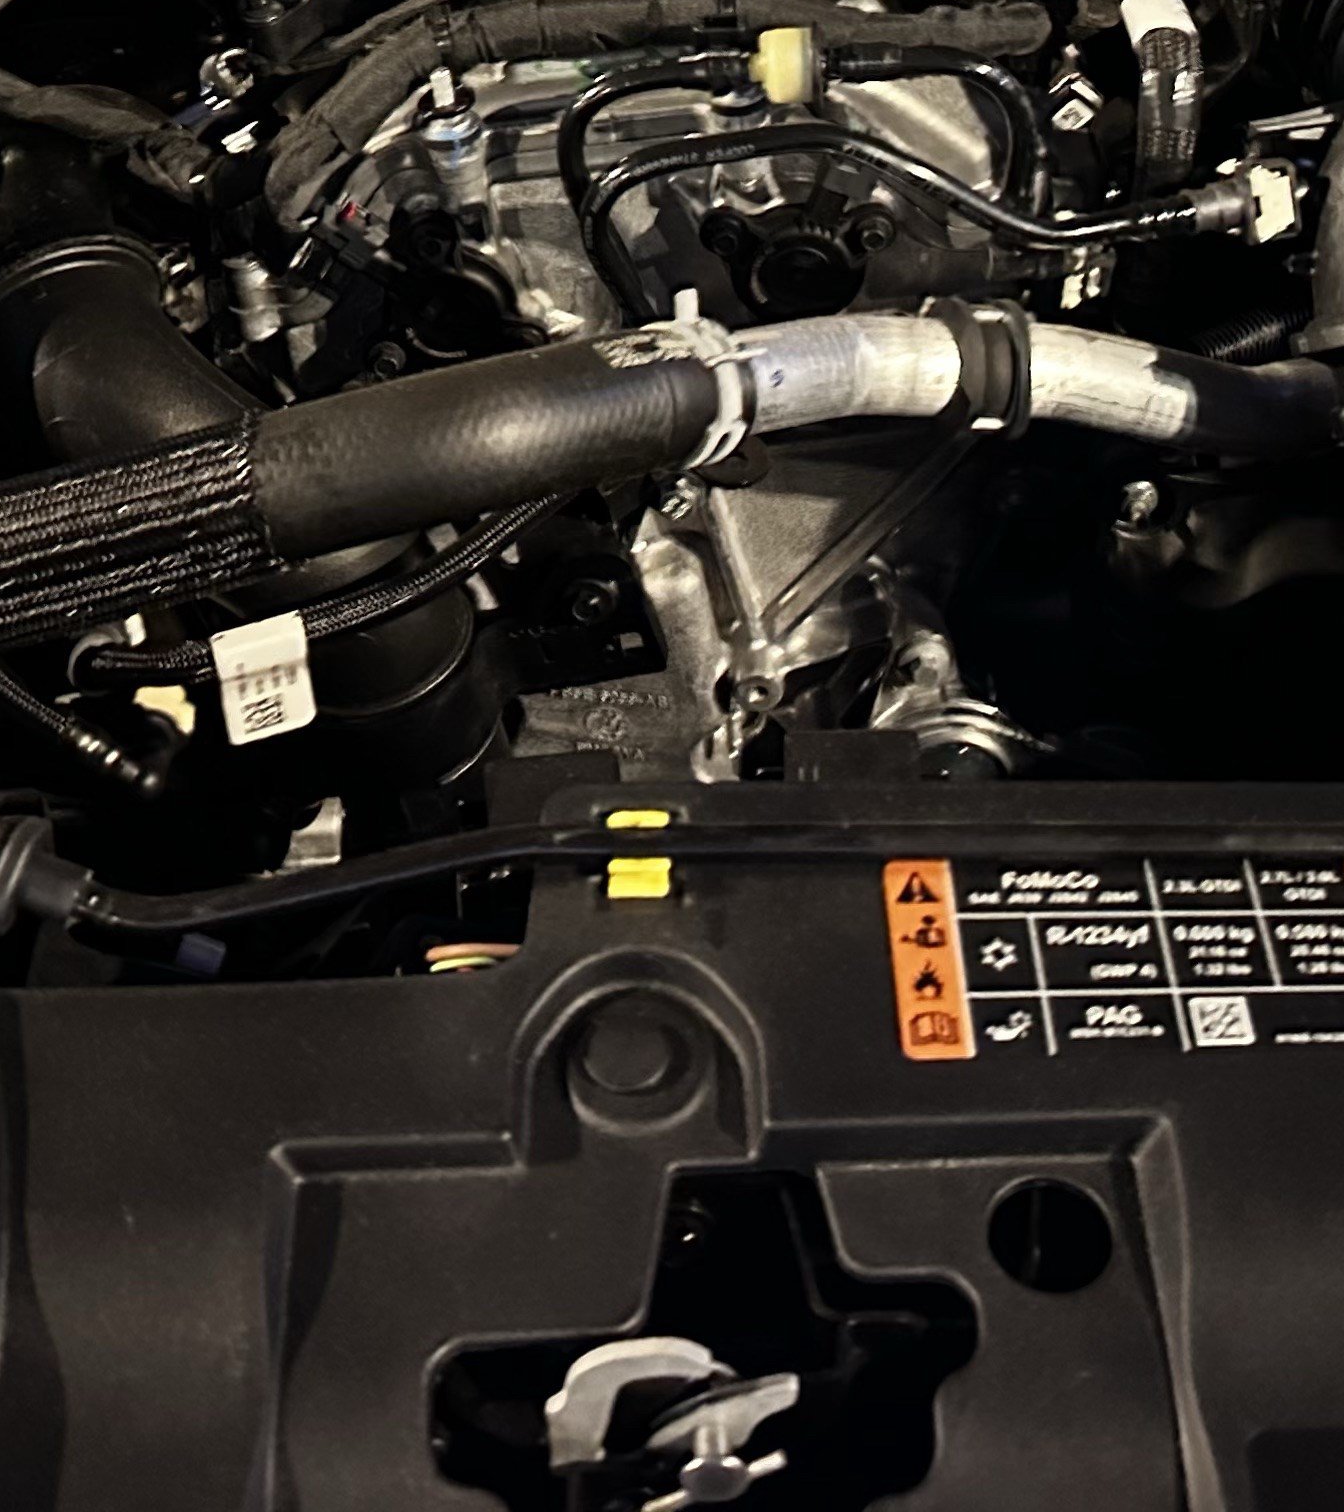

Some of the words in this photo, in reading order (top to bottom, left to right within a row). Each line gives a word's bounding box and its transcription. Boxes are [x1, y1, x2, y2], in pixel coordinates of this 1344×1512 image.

[1001, 871, 1100, 889] FoMoCo
[1046, 924, 1150, 949] R-1234yf
[1086, 1005, 1144, 1026] PAG
